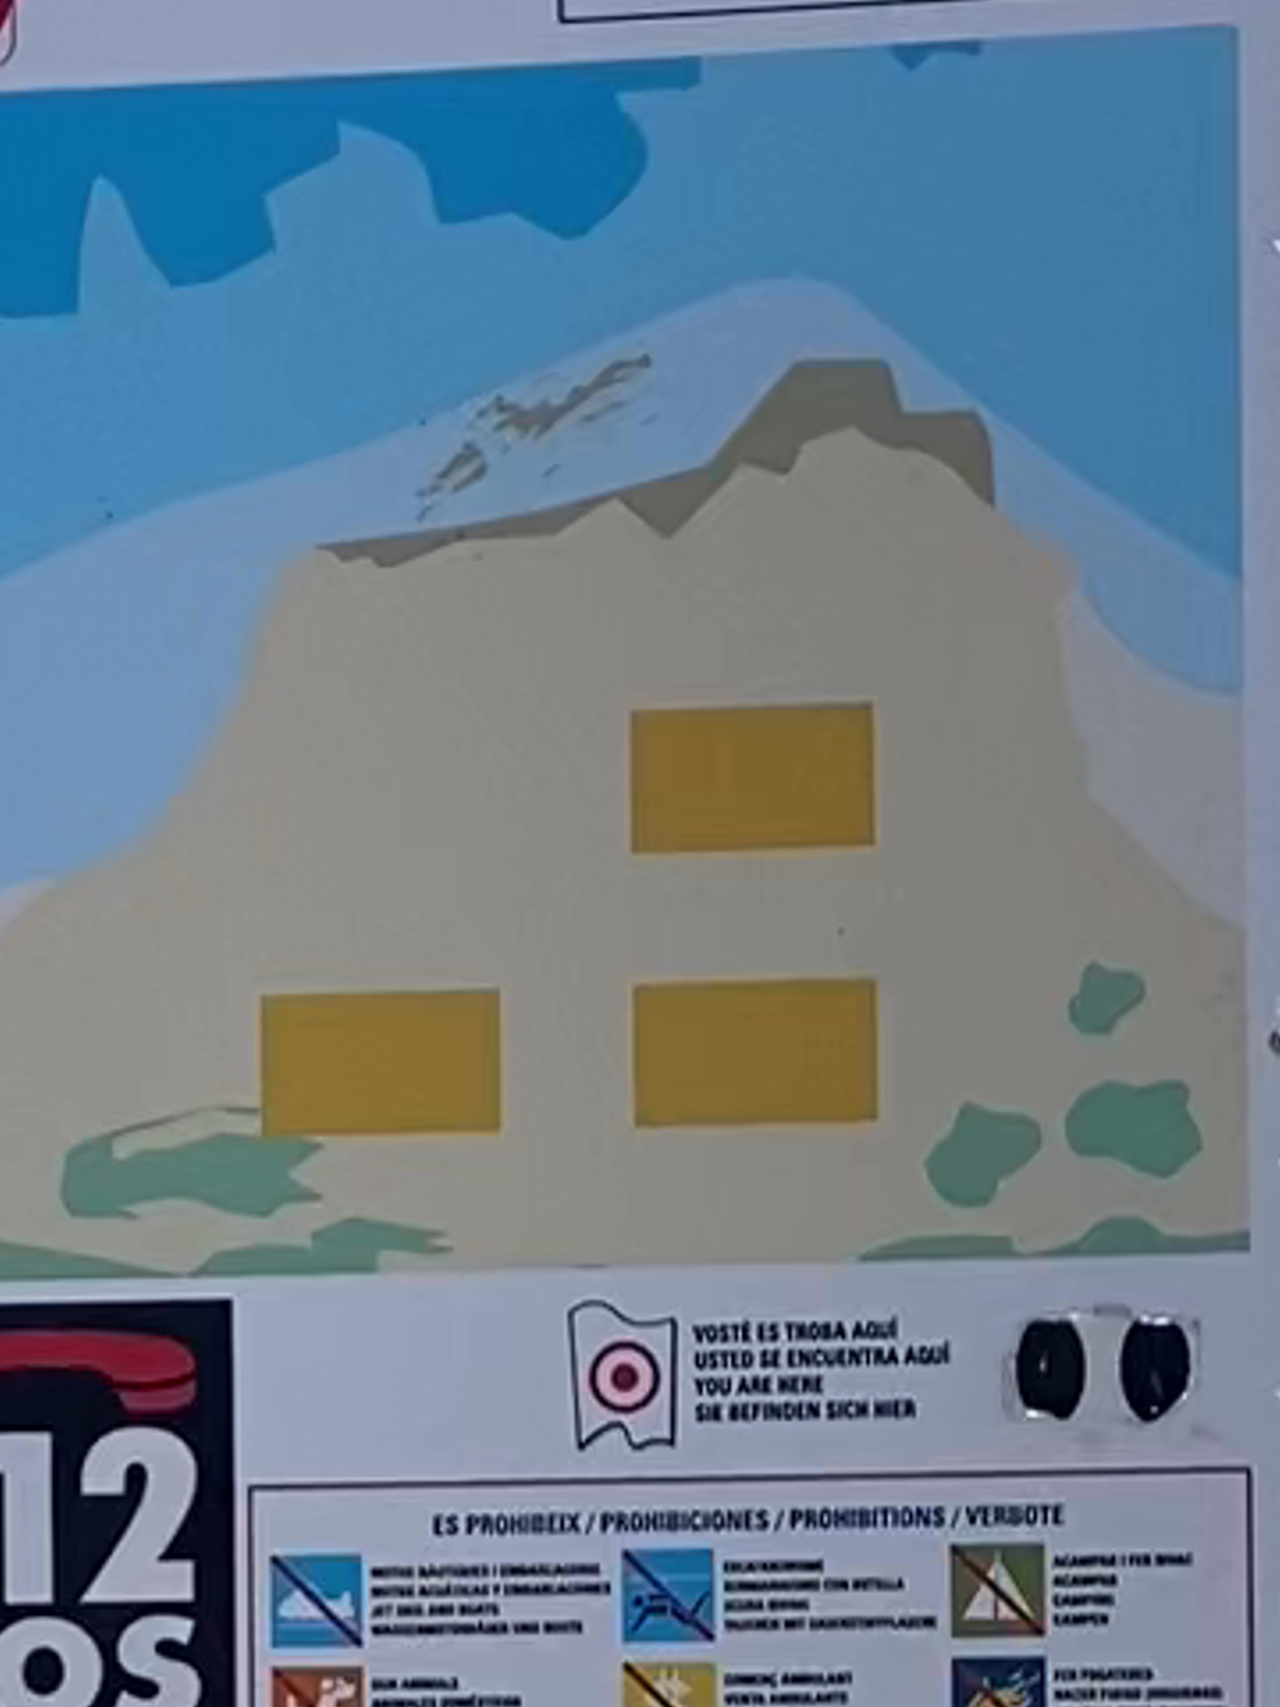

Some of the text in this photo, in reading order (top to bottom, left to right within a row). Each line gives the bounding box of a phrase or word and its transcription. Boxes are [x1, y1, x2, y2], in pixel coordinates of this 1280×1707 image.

[757, 1323, 779, 1342] ES
[785, 1321, 846, 1341] TROBA
[694, 1349, 754, 1370] USTED
[760, 1348, 781, 1368] SE
[787, 1346, 899, 1368] ENCUENTRA
[694, 1374, 823, 1396] YOU ARE HERE
[695, 1398, 917, 1423] SIE BEFINDEN SICH HIER
[432, 1514, 460, 1536] ES
[466, 1511, 581, 1536] PROHIBEIX
[600, 1508, 770, 1534] PROHIBICIONES
[789, 1506, 946, 1532] PROHIBITIONS
[965, 1504, 1065, 1529] VERBOTE
